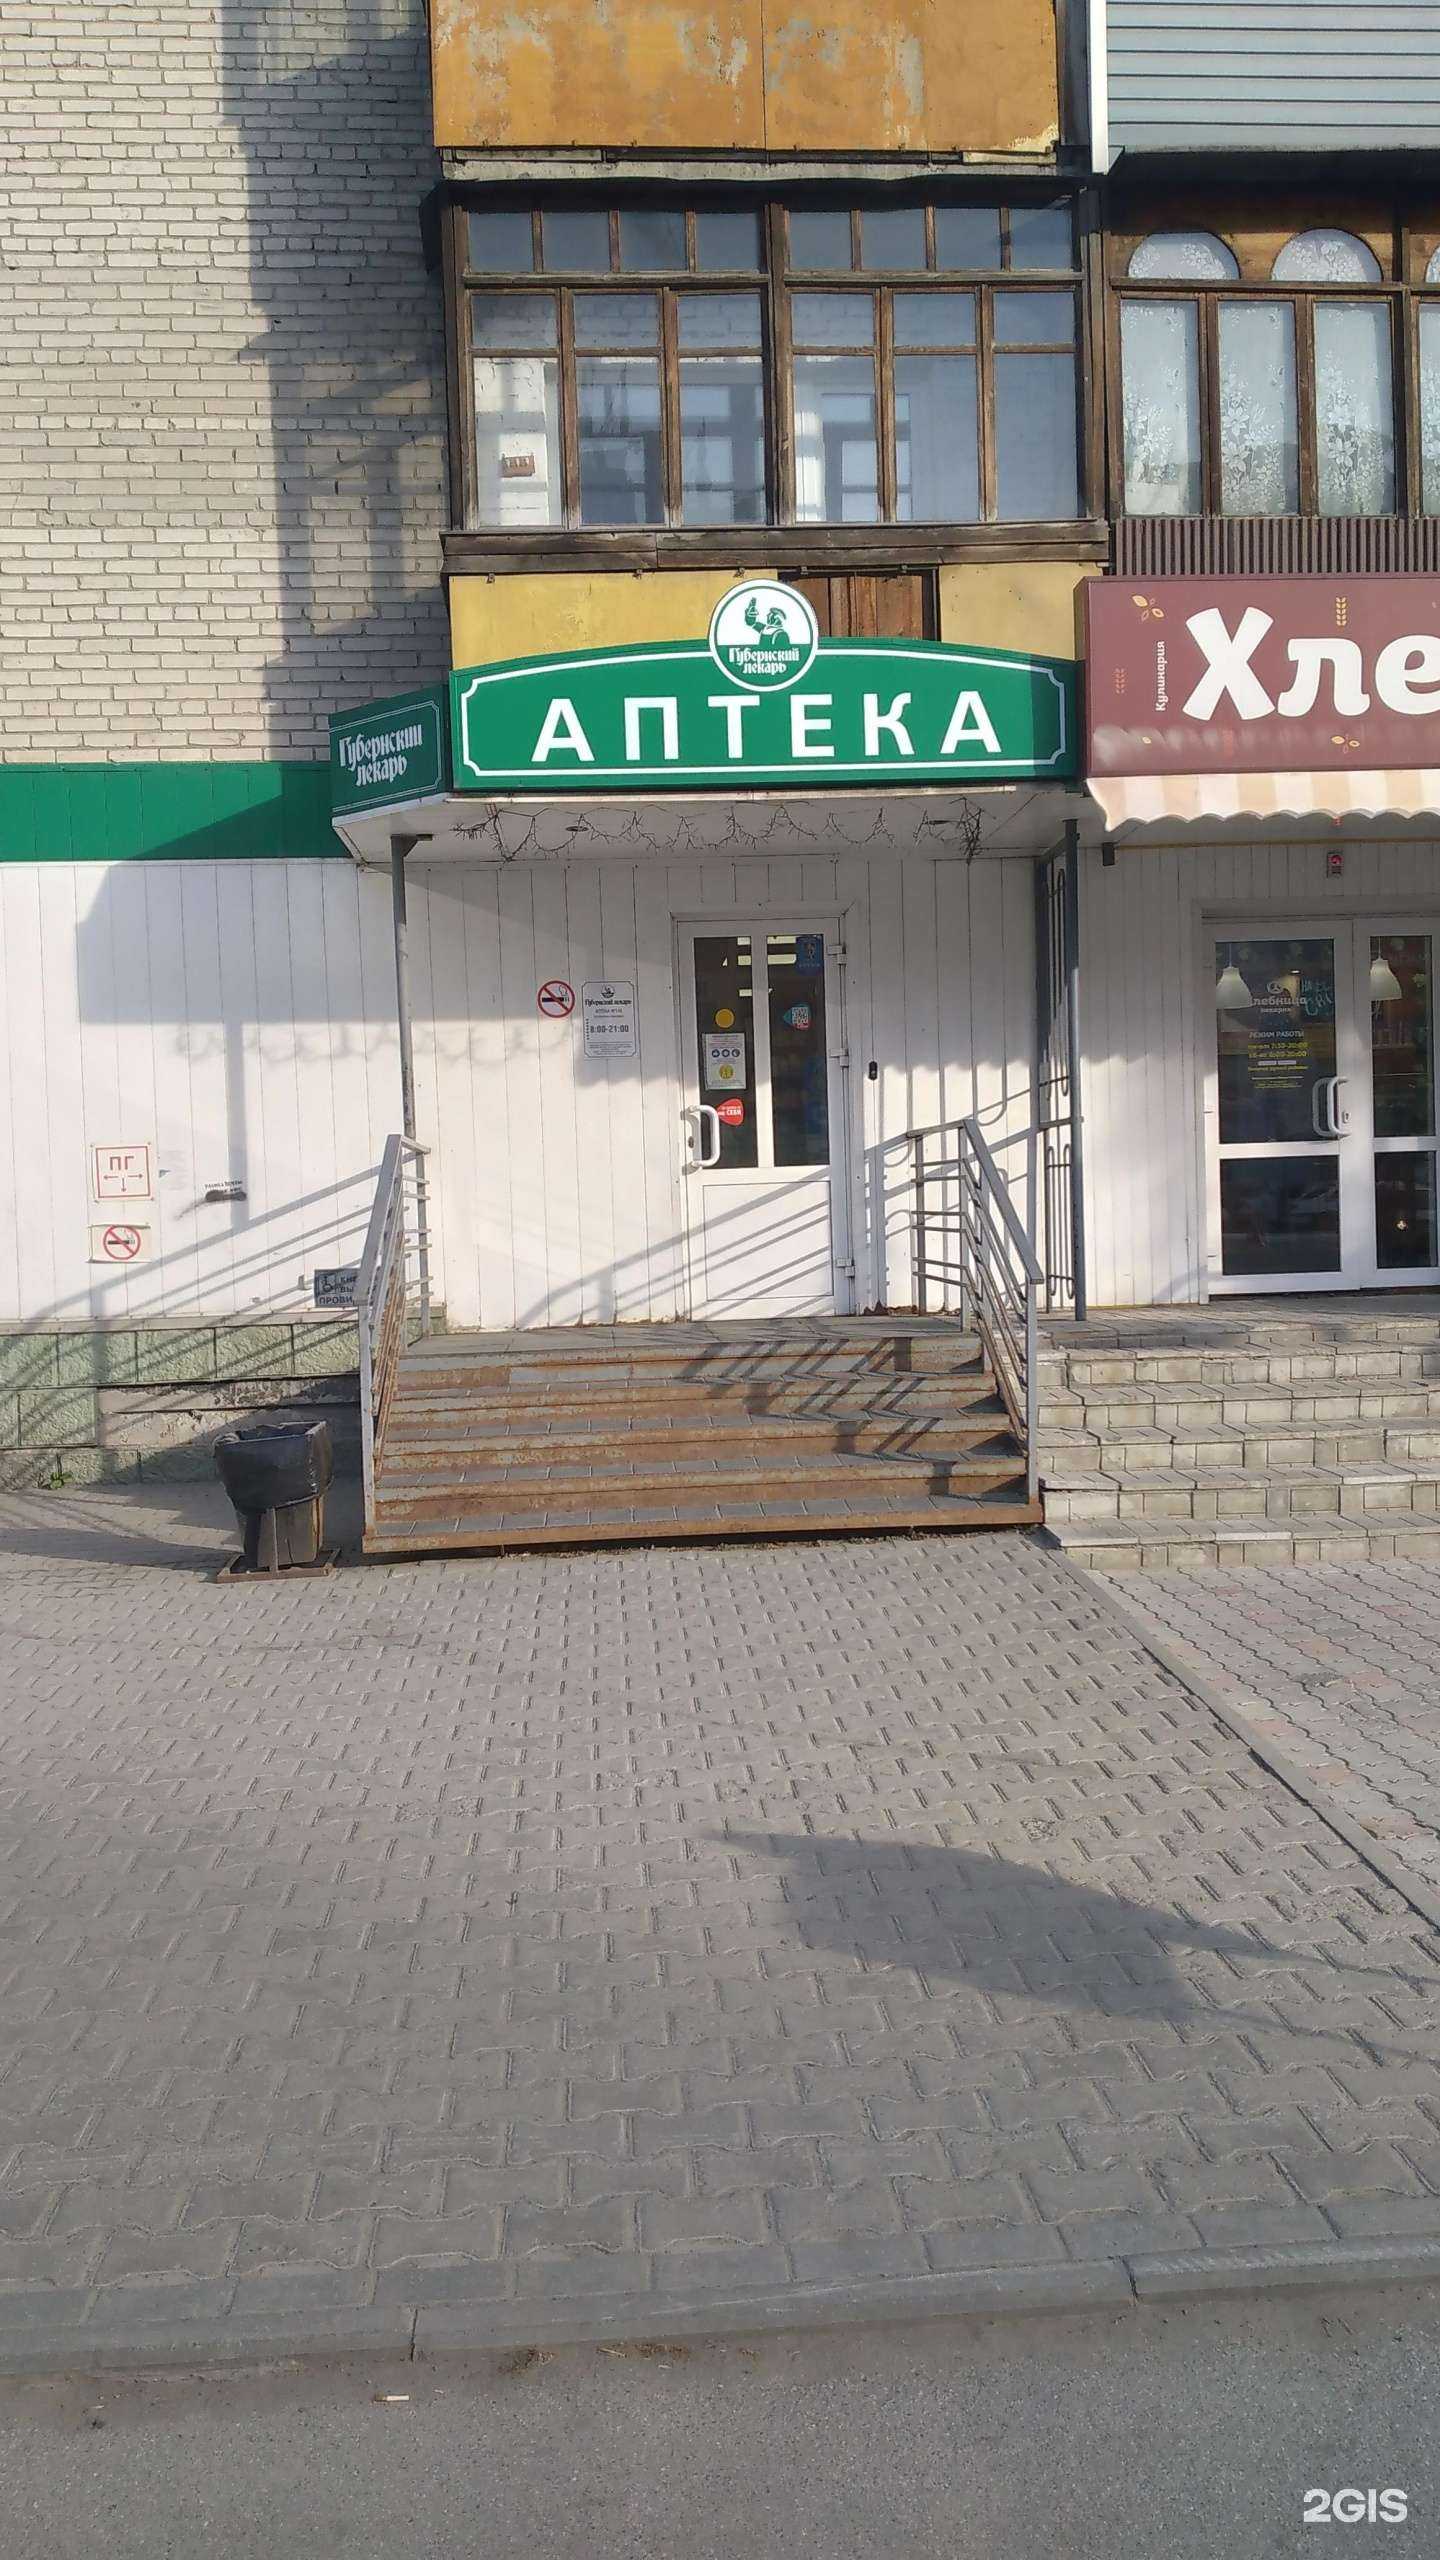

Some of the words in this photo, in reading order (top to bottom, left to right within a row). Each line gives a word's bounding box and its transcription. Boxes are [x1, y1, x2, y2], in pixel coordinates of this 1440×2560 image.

[728, 646, 800, 666] Губернский
[742, 661, 787, 676] лекарь
[1155, 640, 1168, 712] Кулинария
[531, 690, 1003, 763] АПТЕКА
[355, 753, 408, 787] лекарь
[109, 1155, 135, 1171] ПГ
[319, 1296, 353, 1304] ПРОВИ
